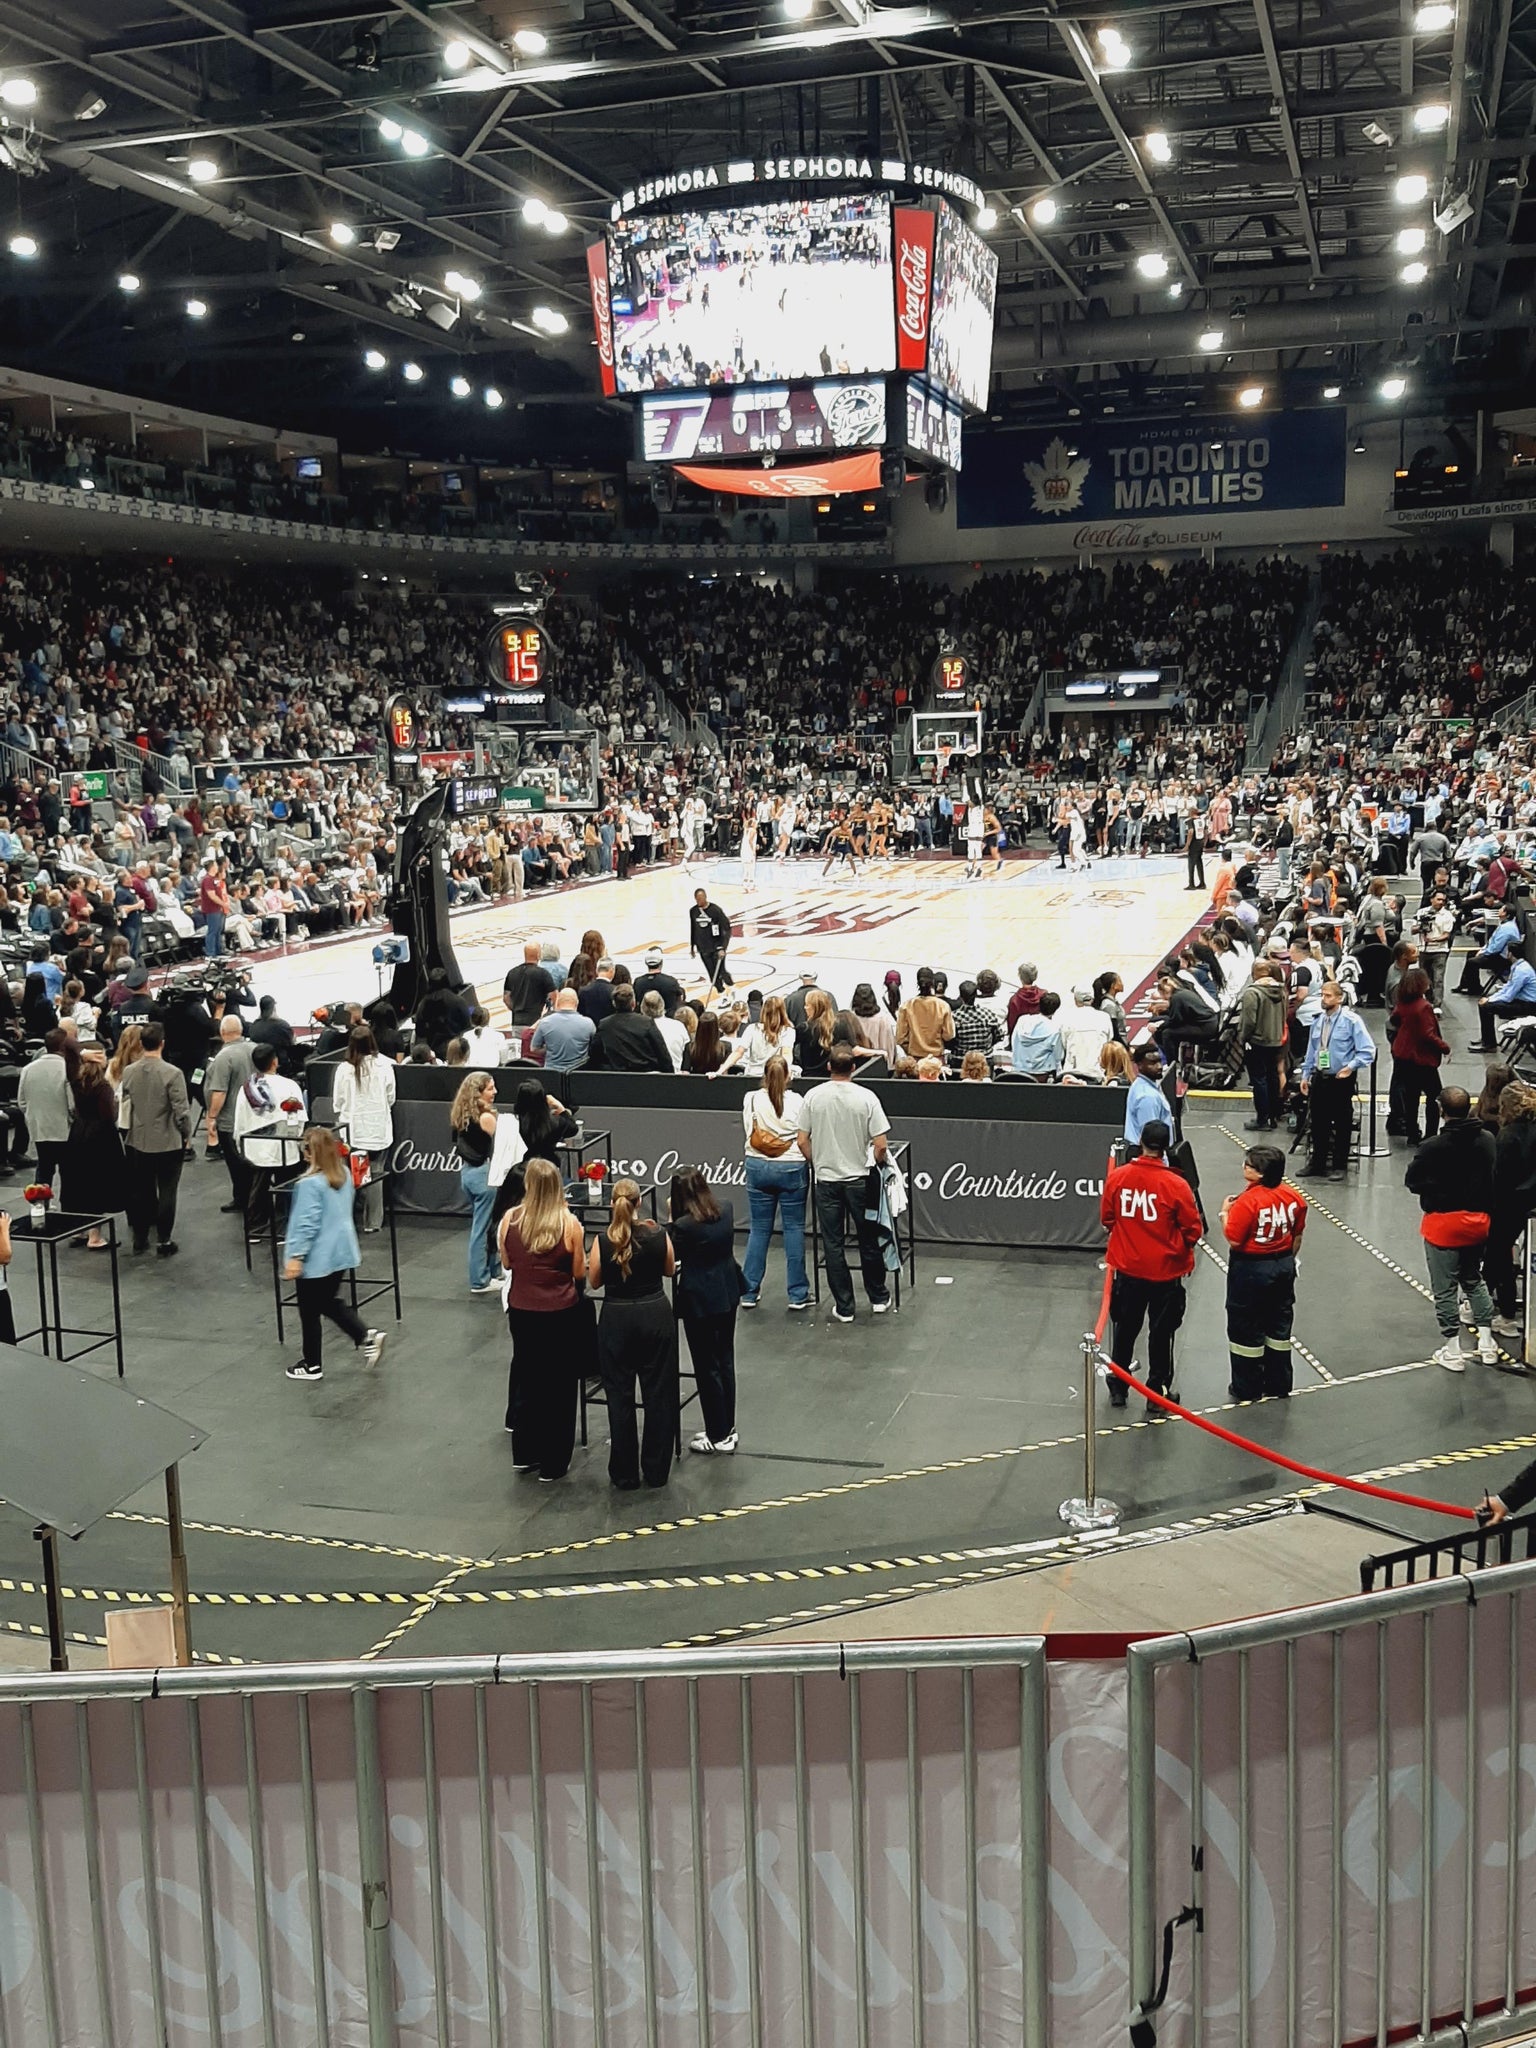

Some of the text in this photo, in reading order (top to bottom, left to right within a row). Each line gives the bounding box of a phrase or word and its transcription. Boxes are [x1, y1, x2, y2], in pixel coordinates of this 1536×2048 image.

[764, 158, 873, 180] SEPHORA
[913, 165, 975, 202] SEPHORA
[638, 166, 719, 205] SEPHORA
[732, 412, 747, 435] 0
[777, 408, 793, 432] 3
[1140, 431, 1179, 440] HOME
[1210, 425, 1239, 434] THE
[1108, 438, 1270, 478] TORONTO
[1114, 471, 1264, 510] MARLIES
[1397, 508, 1459, 521] Developing
[1461, 506, 1492, 516] Leafs
[1494, 502, 1523, 513] since
[513, 652, 538, 682] 15
[947, 672, 961, 689] 15
[121, 1014, 150, 1025] POLICE
[391, 1139, 464, 1174] Courts
[939, 1162, 1067, 1200] Courtside
[1120, 1188, 1158, 1222] EMS
[1254, 1201, 1298, 1243] EMS
